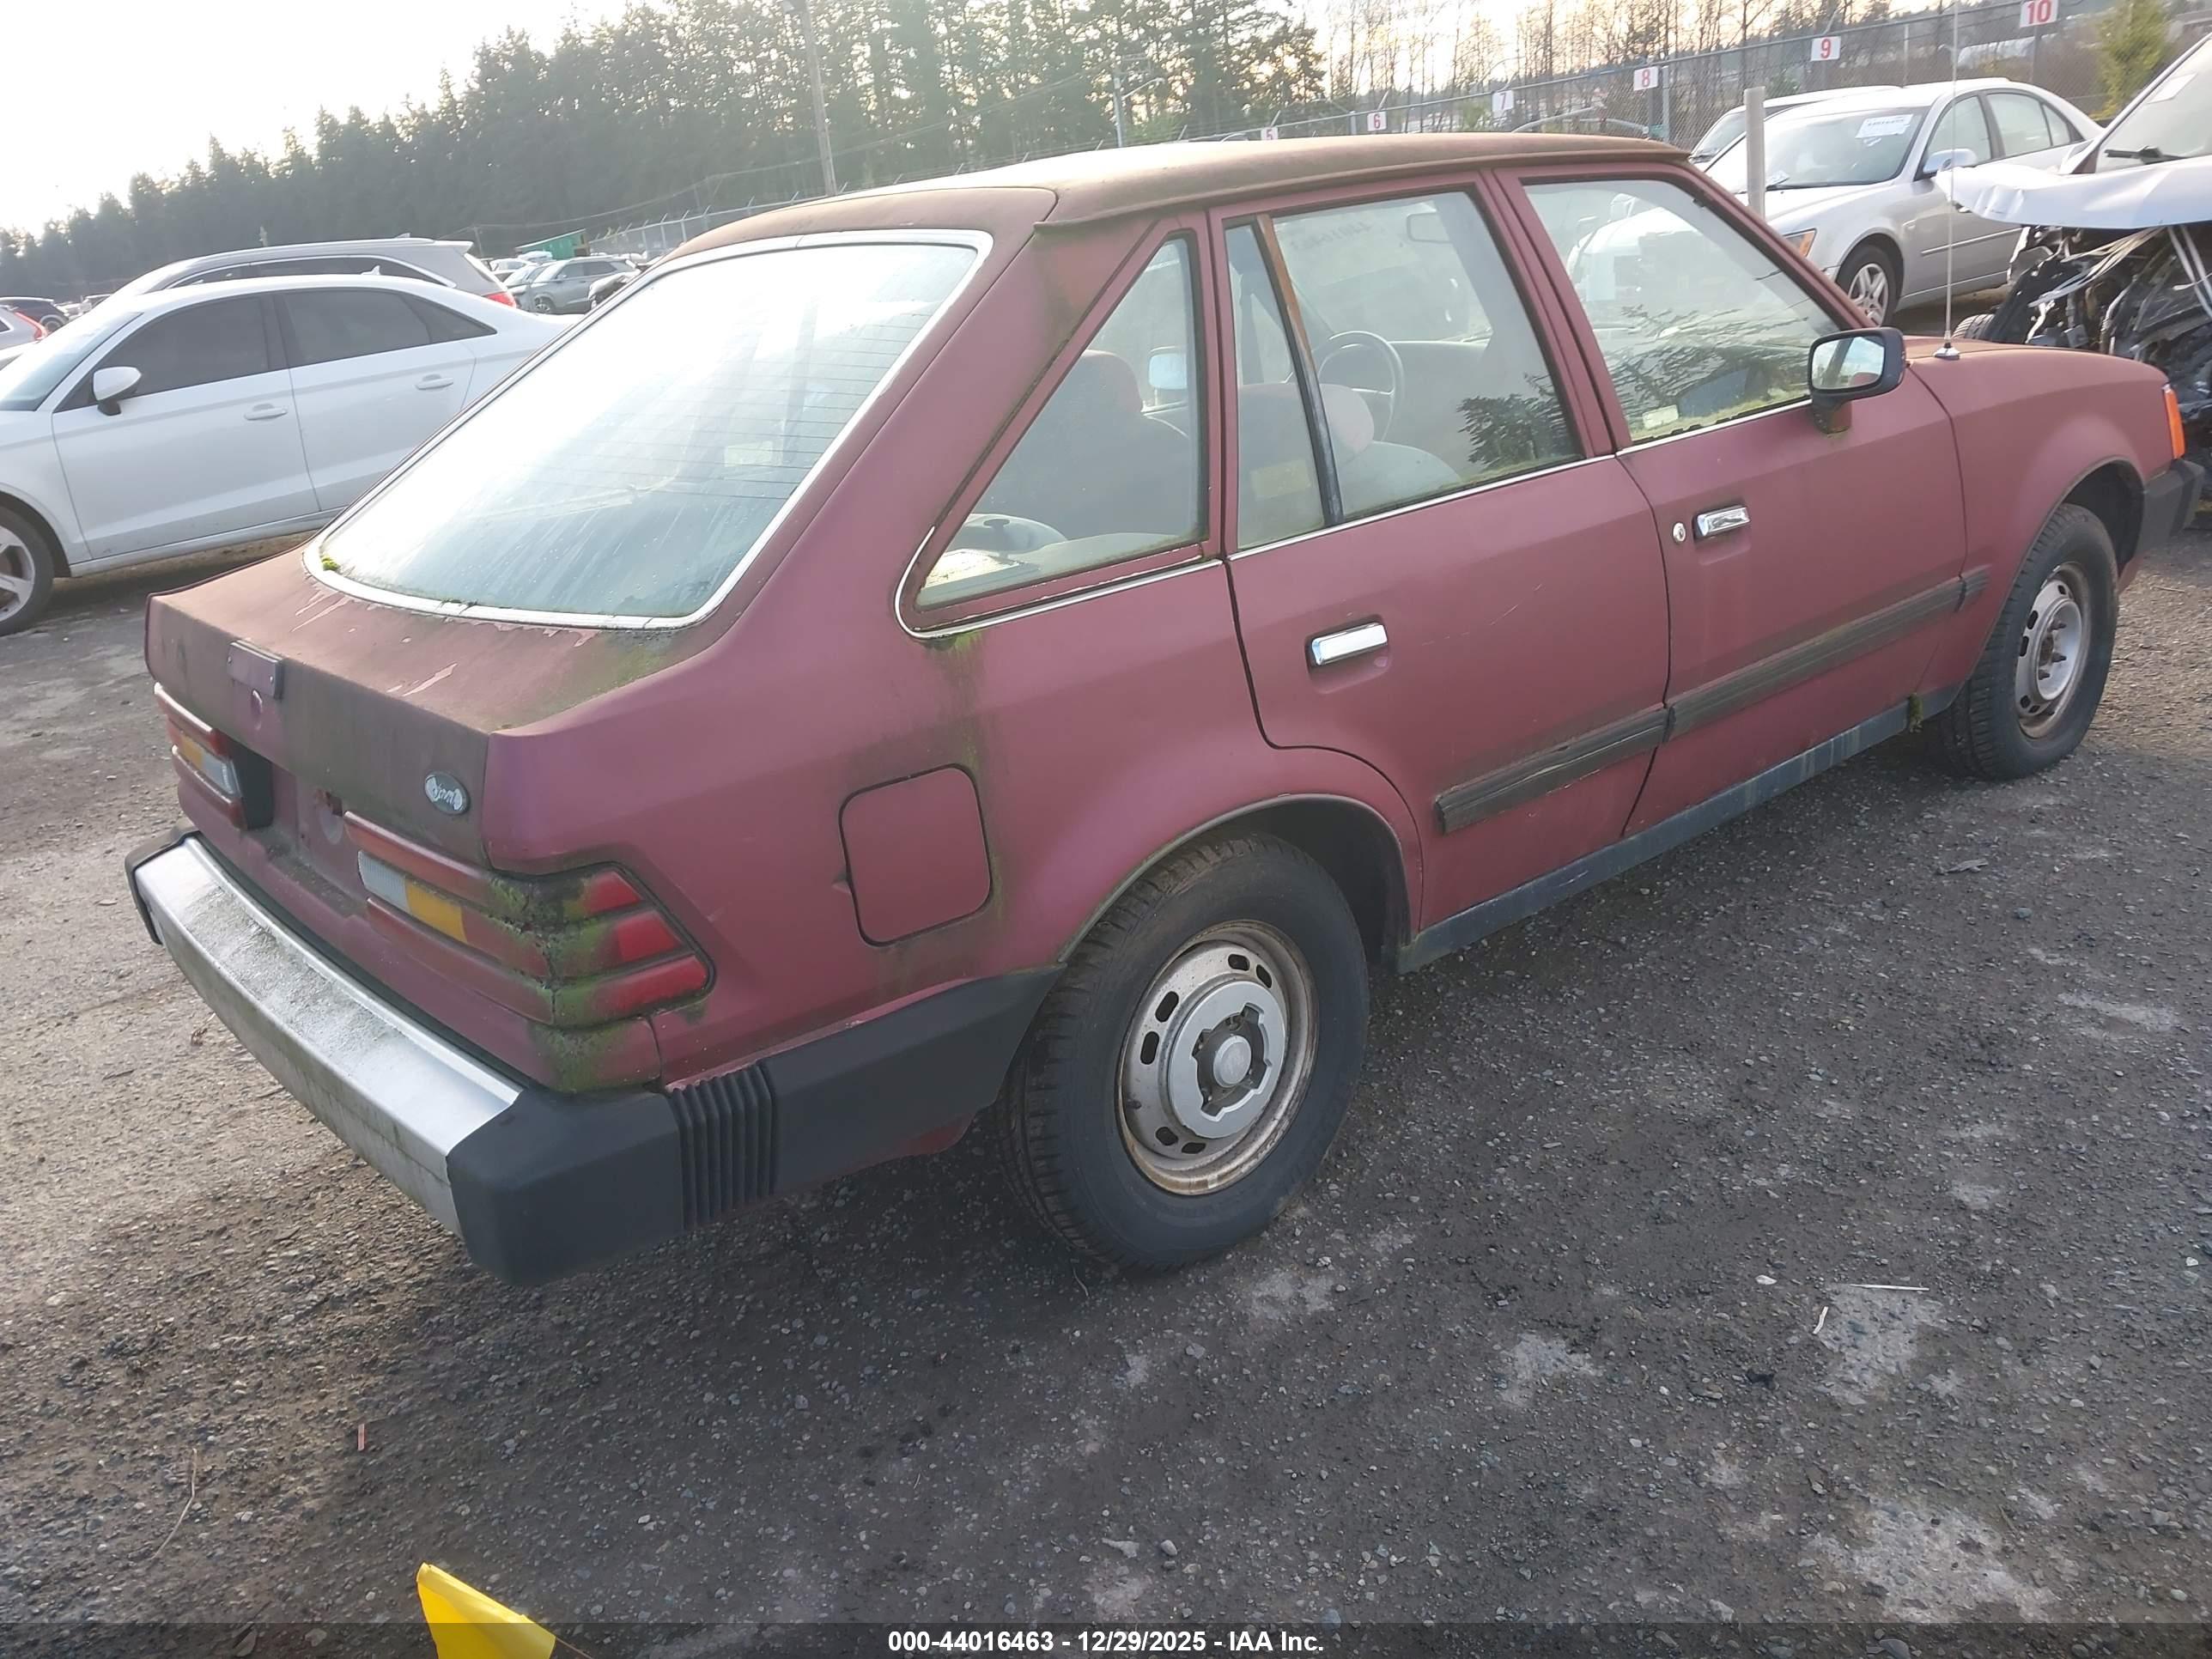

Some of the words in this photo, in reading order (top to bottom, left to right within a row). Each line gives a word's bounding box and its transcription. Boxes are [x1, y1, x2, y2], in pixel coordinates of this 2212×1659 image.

[2027, 0, 2051, 24] 10
[1820, 38, 1831, 58] 9
[1641, 69, 1650, 87] 8
[1498, 92, 1507, 110] 7
[1373, 113, 1381, 129] 6
